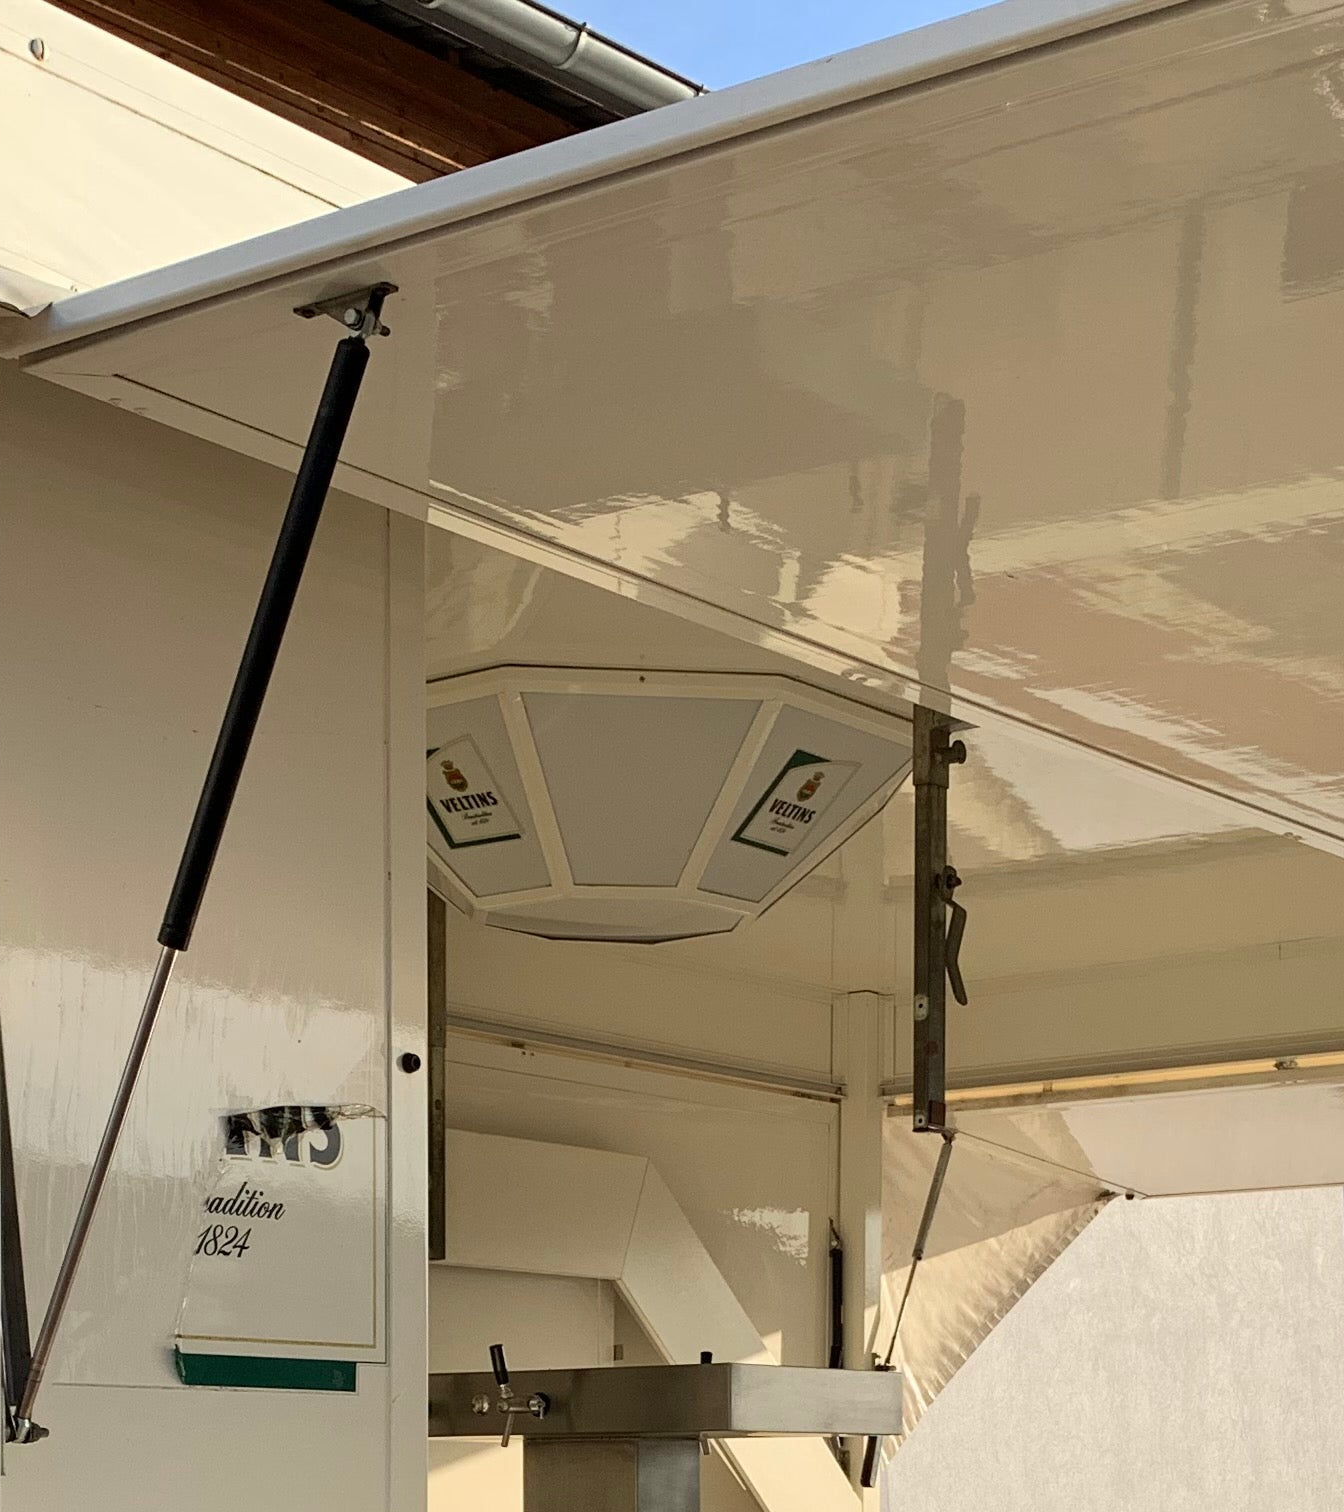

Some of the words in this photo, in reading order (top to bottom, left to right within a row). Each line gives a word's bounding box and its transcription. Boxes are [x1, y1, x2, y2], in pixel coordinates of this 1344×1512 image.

[439, 791, 498, 813] VELTINS
[768, 797, 817, 824] VELTINS
[195, 1224, 252, 1258] 1824
